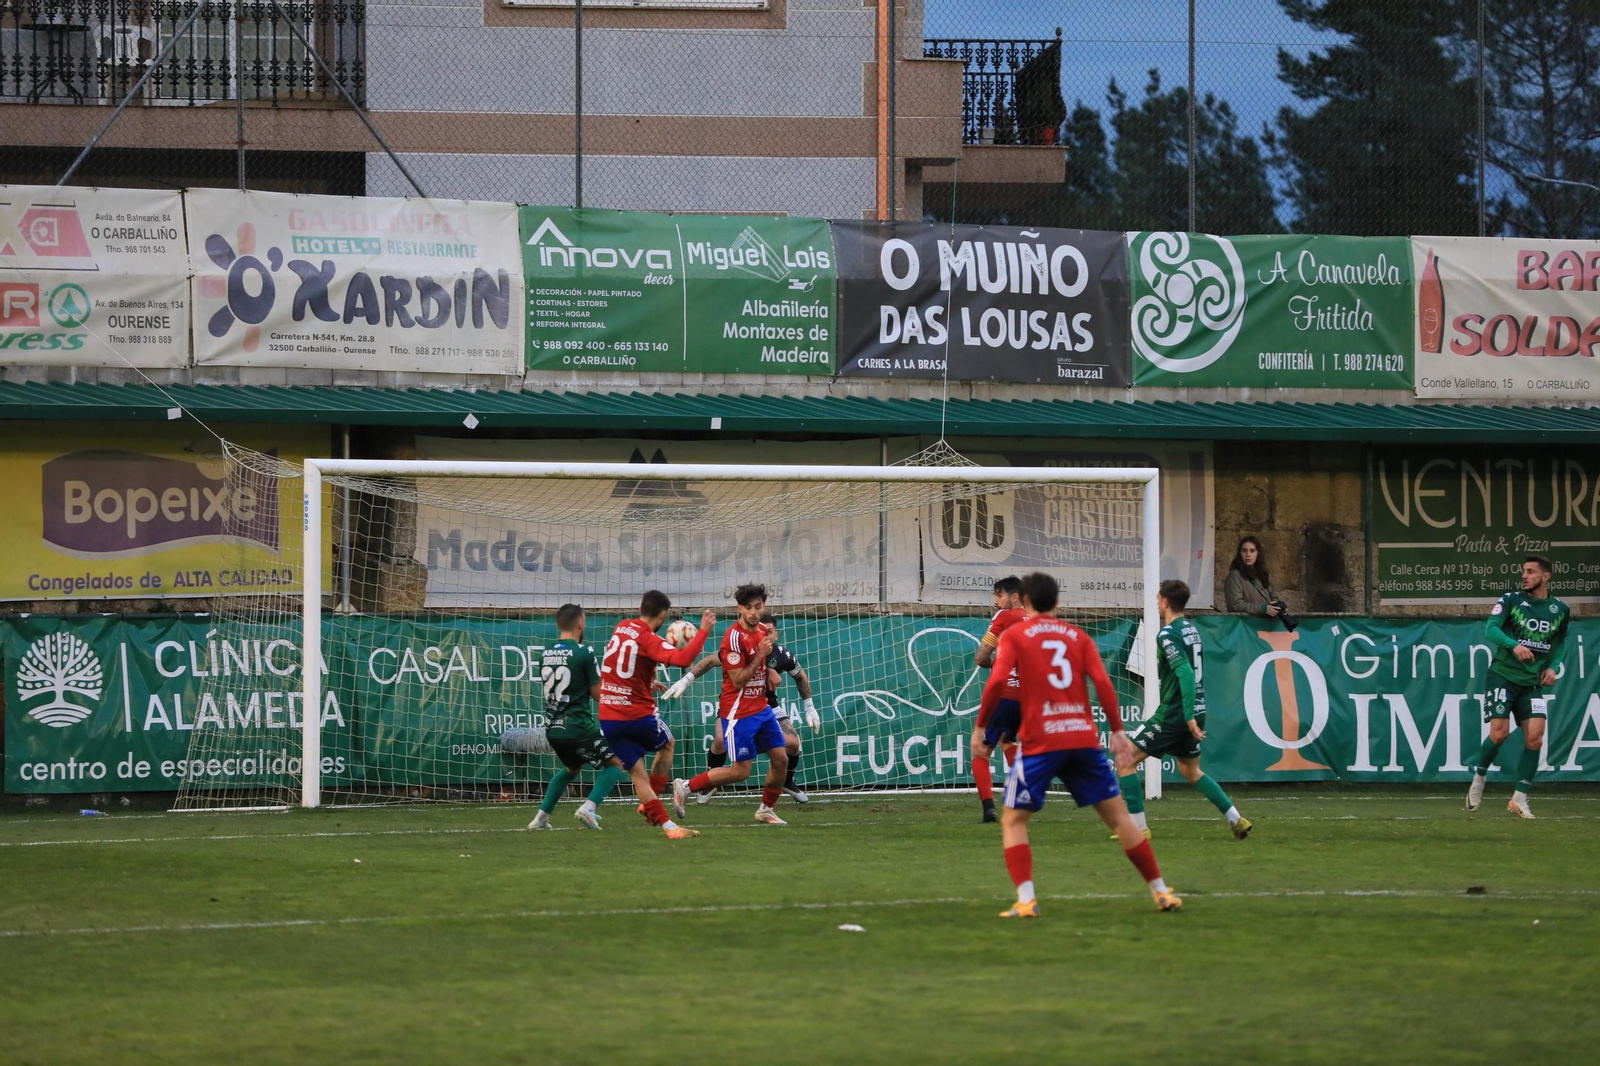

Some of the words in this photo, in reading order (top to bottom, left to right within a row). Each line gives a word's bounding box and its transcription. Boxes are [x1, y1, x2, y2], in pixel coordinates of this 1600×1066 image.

[95, 213, 114, 221] Avda.
[127, 214, 161, 223] Balneario,
[91, 227, 100, 239] O
[103, 226, 177, 240] CARBALLIÑO
[105, 245, 124, 253] Tfno.
[296, 238, 363, 253] HOTEL
[387, 240, 477, 258] RESTAURANTE
[687, 241, 769, 270] Miguel
[783, 244, 831, 269] Lois
[880, 238, 920, 291] O
[937, 230, 1089, 298] MUIÑO
[1257, 251, 1289, 285] A
[1298, 250, 1401, 286] Canavela
[644, 272, 675, 286] decor
[536, 288, 582, 296] DECORACIÓN
[588, 289, 610, 297] PAPEL
[95, 300, 107, 308] Av.
[108, 300, 118, 308] de
[119, 300, 146, 309] Buenos
[147, 301, 169, 309] Aires,
[171, 301, 184, 309] 134
[742, 300, 828, 318] Albañilería
[1288, 295, 1374, 331] Fritida
[108, 315, 171, 329] OURENSE
[571, 321, 606, 329] INTEGRAL
[879, 305, 949, 346] DAS
[961, 306, 1094, 353] LOUSAS
[108, 335, 127, 343] Tfno.
[128, 335, 142, 344] 988
[143, 336, 157, 344] 318
[270, 332, 310, 341] Carretera
[313, 334, 338, 343] N-541,
[358, 335, 375, 343] 28.8
[723, 322, 804, 340] Montaxes
[809, 324, 828, 341] de
[0, 332, 88, 351] ress
[269, 344, 294, 352] 32500
[297, 345, 337, 353] Carballiño
[543, 341, 562, 349] 988
[564, 341, 583, 350] 092
[586, 341, 605, 350] 400
[614, 342, 632, 350] 665
[635, 342, 650, 351] 133
[652, 343, 669, 351] 140
[389, 345, 411, 355] Tfno.
[415, 347, 430, 355] 988
[432, 348, 446, 356] 271
[467, 349, 483, 357] 988
[486, 349, 500, 358] 530
[760, 346, 829, 364] Madeira
[563, 356, 571, 365] O
[573, 355, 637, 366] CARBALLIÑO
[858, 358, 891, 369] CARNES
[894, 359, 901, 369] A
[903, 359, 916, 369] LA
[918, 359, 948, 370] BRASA
[1258, 349, 1314, 371] CONFITERÍA
[1333, 353, 1342, 371] T.
[1344, 354, 1363, 371] 988
[1365, 354, 1383, 371] 274
[1385, 354, 1404, 371] 620
[1057, 364, 1104, 379] barazal
[1421, 377, 1452, 389] Conde
[1454, 378, 1499, 390] Vallellano,
[1502, 378, 1514, 389] 15
[1527, 380, 1535, 389] O
[1536, 379, 1590, 390] CARBALLIÑO
[1379, 458, 1600, 528] VENTUR
[64, 480, 257, 539] Bopeixe
[1044, 499, 1143, 539] CRISTOB
[427, 528, 604, 573] Maderas
[1456, 534, 1491, 553] Pasta
[1495, 537, 1510, 555] &
[1514, 534, 1549, 553] Pizza
[1390, 564, 1412, 575] Calle
[1415, 564, 1440, 575] Cerca
[1443, 564, 1456, 575] Nº
[1459, 564, 1470, 575] 17
[1473, 564, 1493, 577] bajo
[1500, 564, 1509, 574] O
[28, 572, 133, 594] Congelados
[139, 571, 162, 589] de
[173, 570, 213, 588] ALTA
[218, 568, 294, 587] CALIDAD
[828, 582, 849, 597] 988
[852, 581, 894, 597] 21593
[1081, 581, 1095, 591] 988
[1097, 582, 1110, 591] 214
[1416, 580, 1433, 591] 988
[1435, 580, 1453, 591] 545
[1455, 580, 1473, 591] 996
[1481, 579, 1513, 590] E-mail.
[1526, 618, 1550, 633] OB
[542, 649, 573, 657] ABANCA
[601, 635, 639, 679] 20
[368, 645, 490, 685] CASAL
[501, 645, 545, 683] DE
[1041, 640, 1073, 690] 3
[541, 665, 571, 702] 22
[1494, 687, 1507, 703] 14
[485, 714, 546, 734] RIBEIR
[20, 756, 107, 781] centro
[117, 751, 151, 779] de
[161, 748, 346, 783] especialidaes
